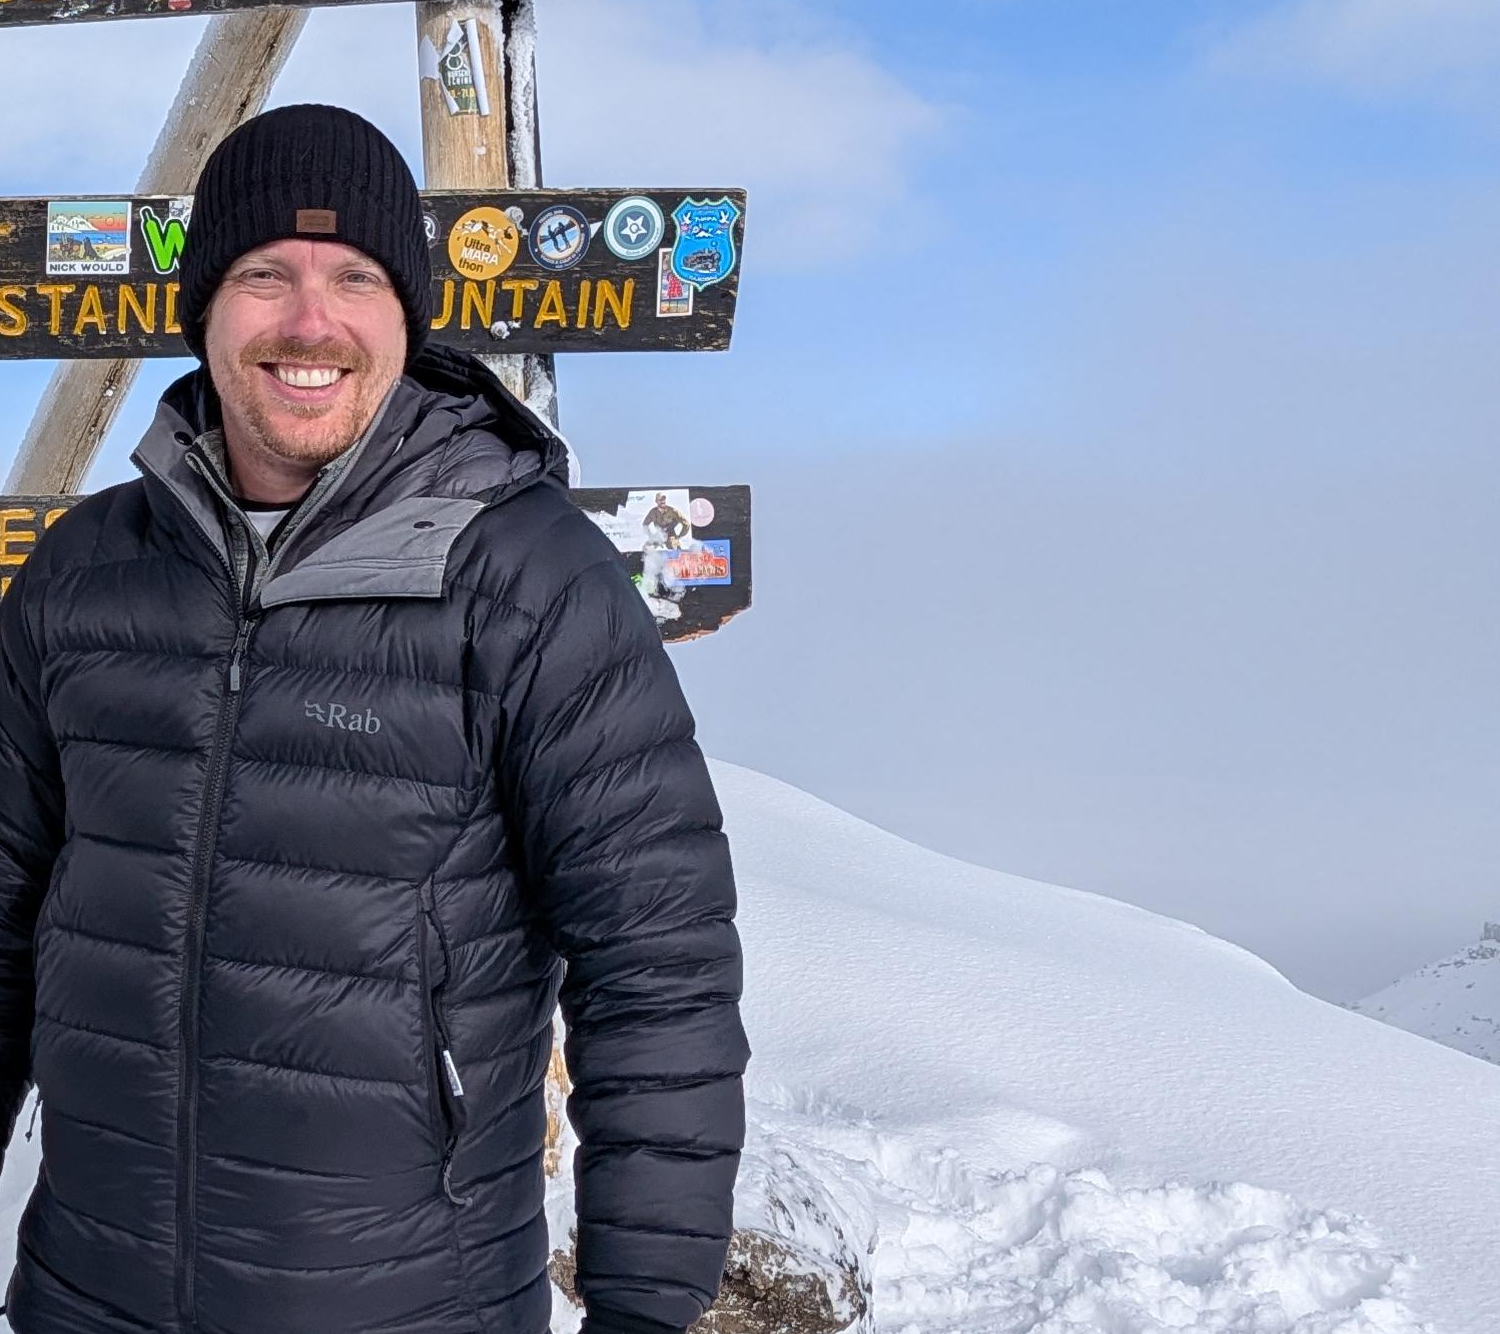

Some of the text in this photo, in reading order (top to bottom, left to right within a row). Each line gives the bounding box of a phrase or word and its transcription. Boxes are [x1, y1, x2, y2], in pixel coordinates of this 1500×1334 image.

[460, 248, 499, 266] MARA
[50, 263, 125, 272] NICK WOULD
[458, 258, 485, 274] thon
[325, 701, 382, 735] Rab
